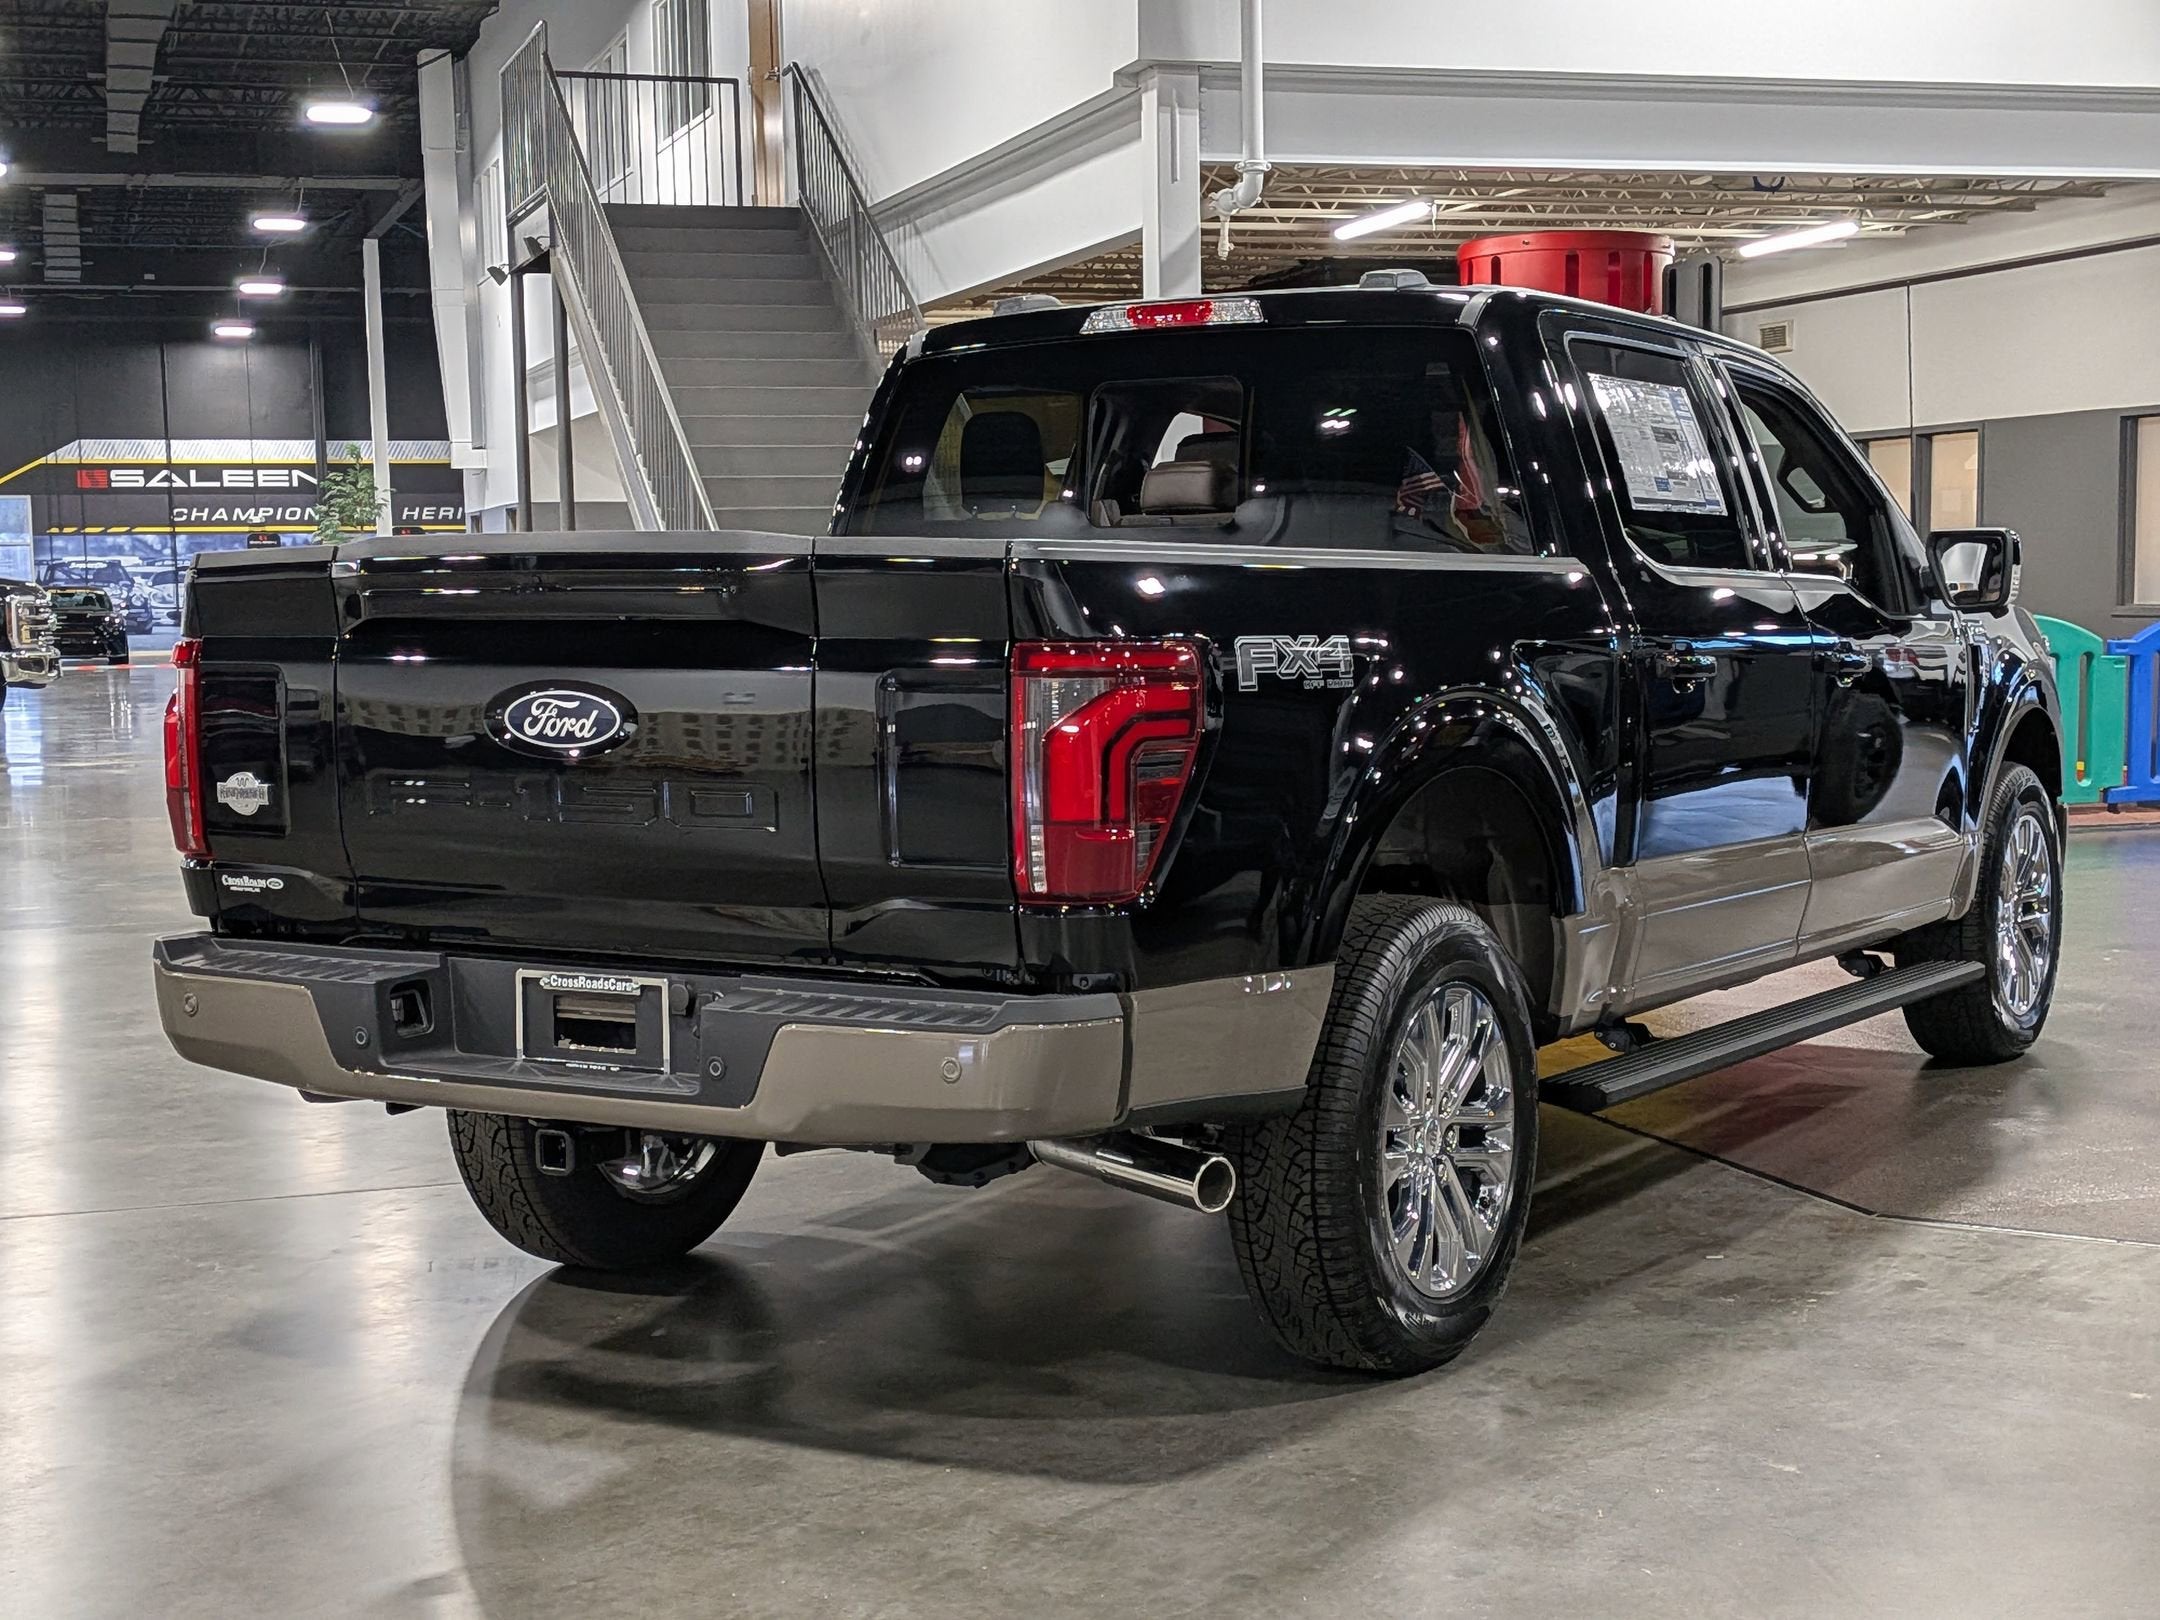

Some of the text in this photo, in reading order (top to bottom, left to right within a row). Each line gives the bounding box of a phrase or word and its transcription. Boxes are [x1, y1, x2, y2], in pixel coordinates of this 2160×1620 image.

[109, 469, 318, 488] SALEEN
[1234, 635, 1354, 691] FX4
[523, 698, 600, 738] Ford
